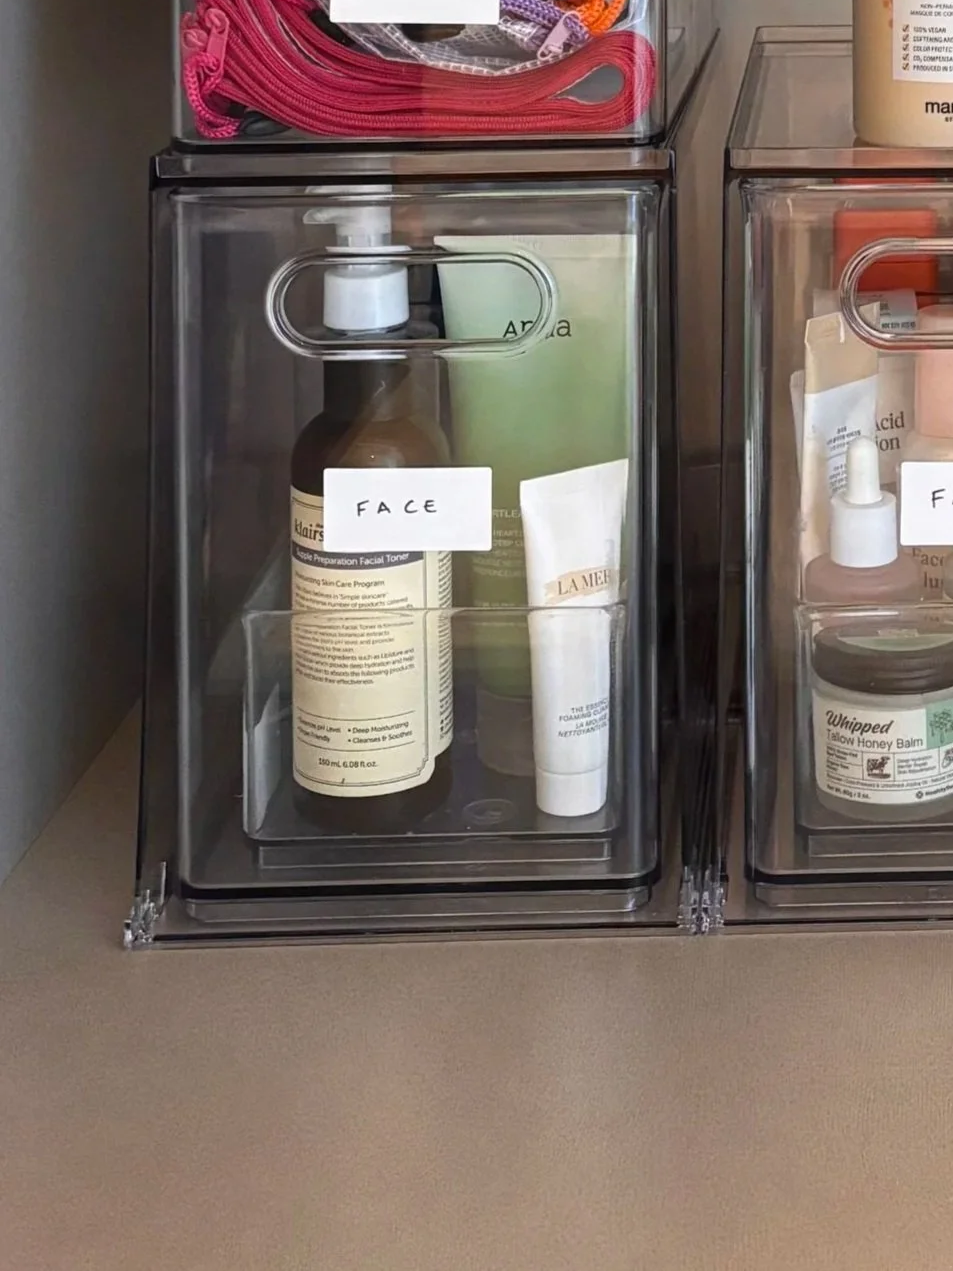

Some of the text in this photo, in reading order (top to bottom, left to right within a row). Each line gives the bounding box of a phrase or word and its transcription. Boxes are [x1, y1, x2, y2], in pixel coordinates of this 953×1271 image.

[875, 437, 901, 452] ion
[357, 499, 438, 517] FACE
[313, 553, 358, 566] Preparation
[360, 555, 384, 565] Facial
[386, 553, 409, 563] Toner
[335, 579, 352, 588] Care
[353, 579, 385, 589] Program
[558, 578, 579, 595] LA
[825, 710, 895, 736] Whipped
[826, 729, 924, 751] Tallow Honey Balm
